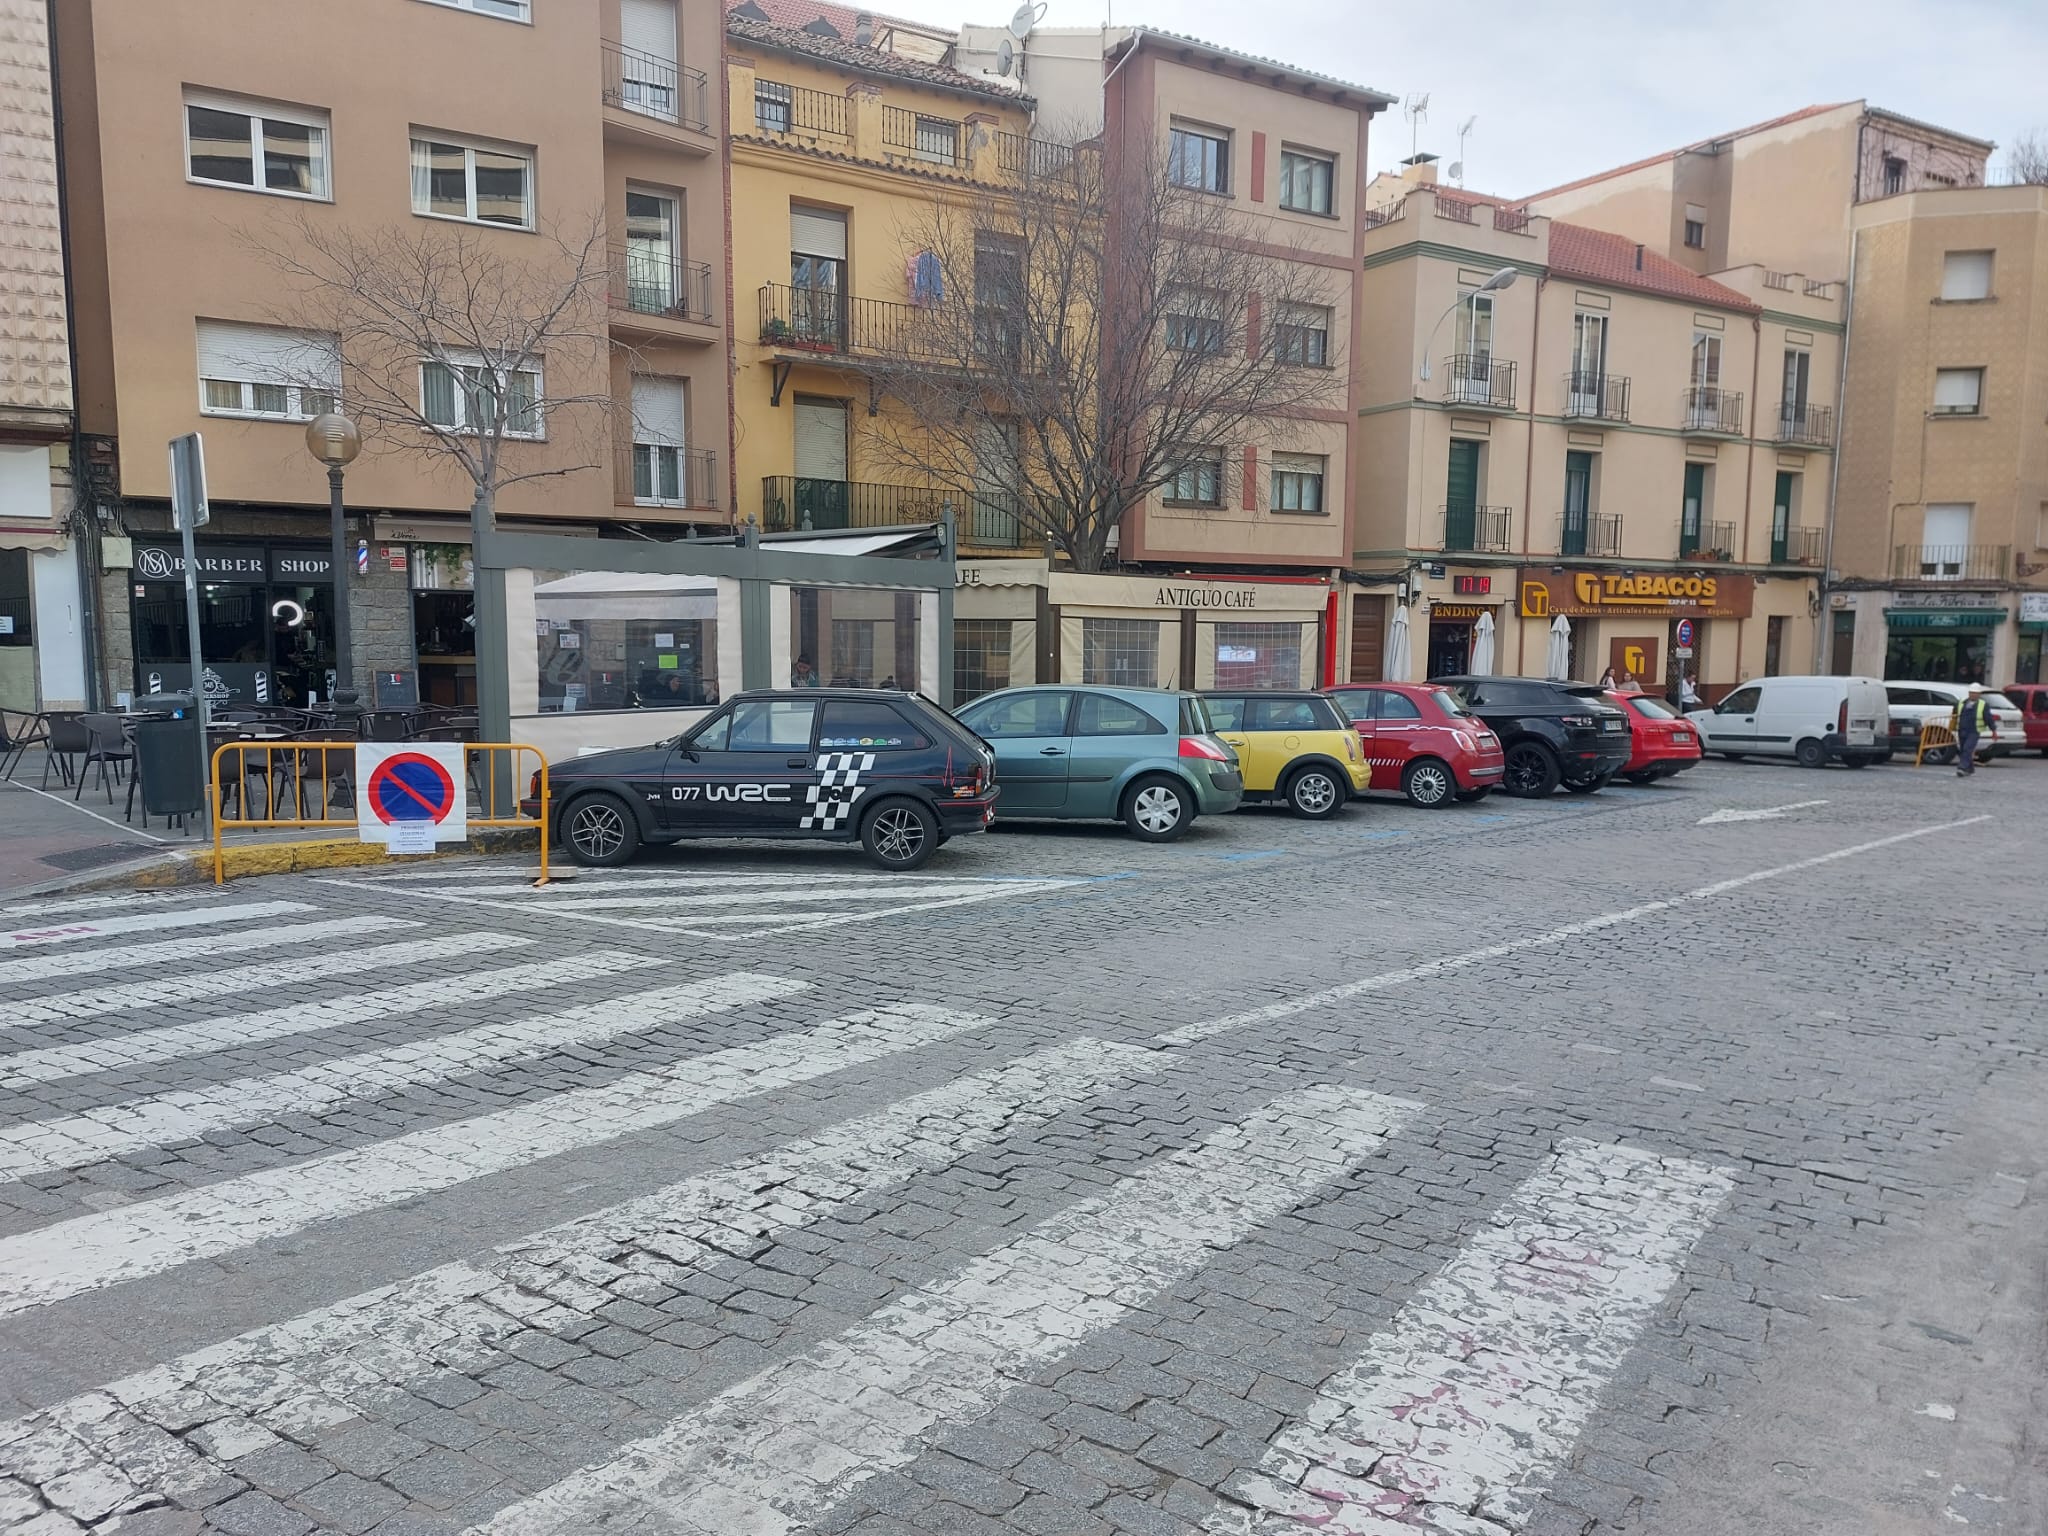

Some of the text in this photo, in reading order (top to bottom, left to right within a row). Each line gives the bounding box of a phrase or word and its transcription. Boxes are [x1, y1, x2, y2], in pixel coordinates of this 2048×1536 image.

[280, 559, 330, 573] SHOP
[1602, 575, 1718, 598] TABACOS
[1155, 587, 1256, 608] ANTIGUO CAFÉ
[671, 786, 701, 801] 077
[705, 783, 792, 802] WRC
